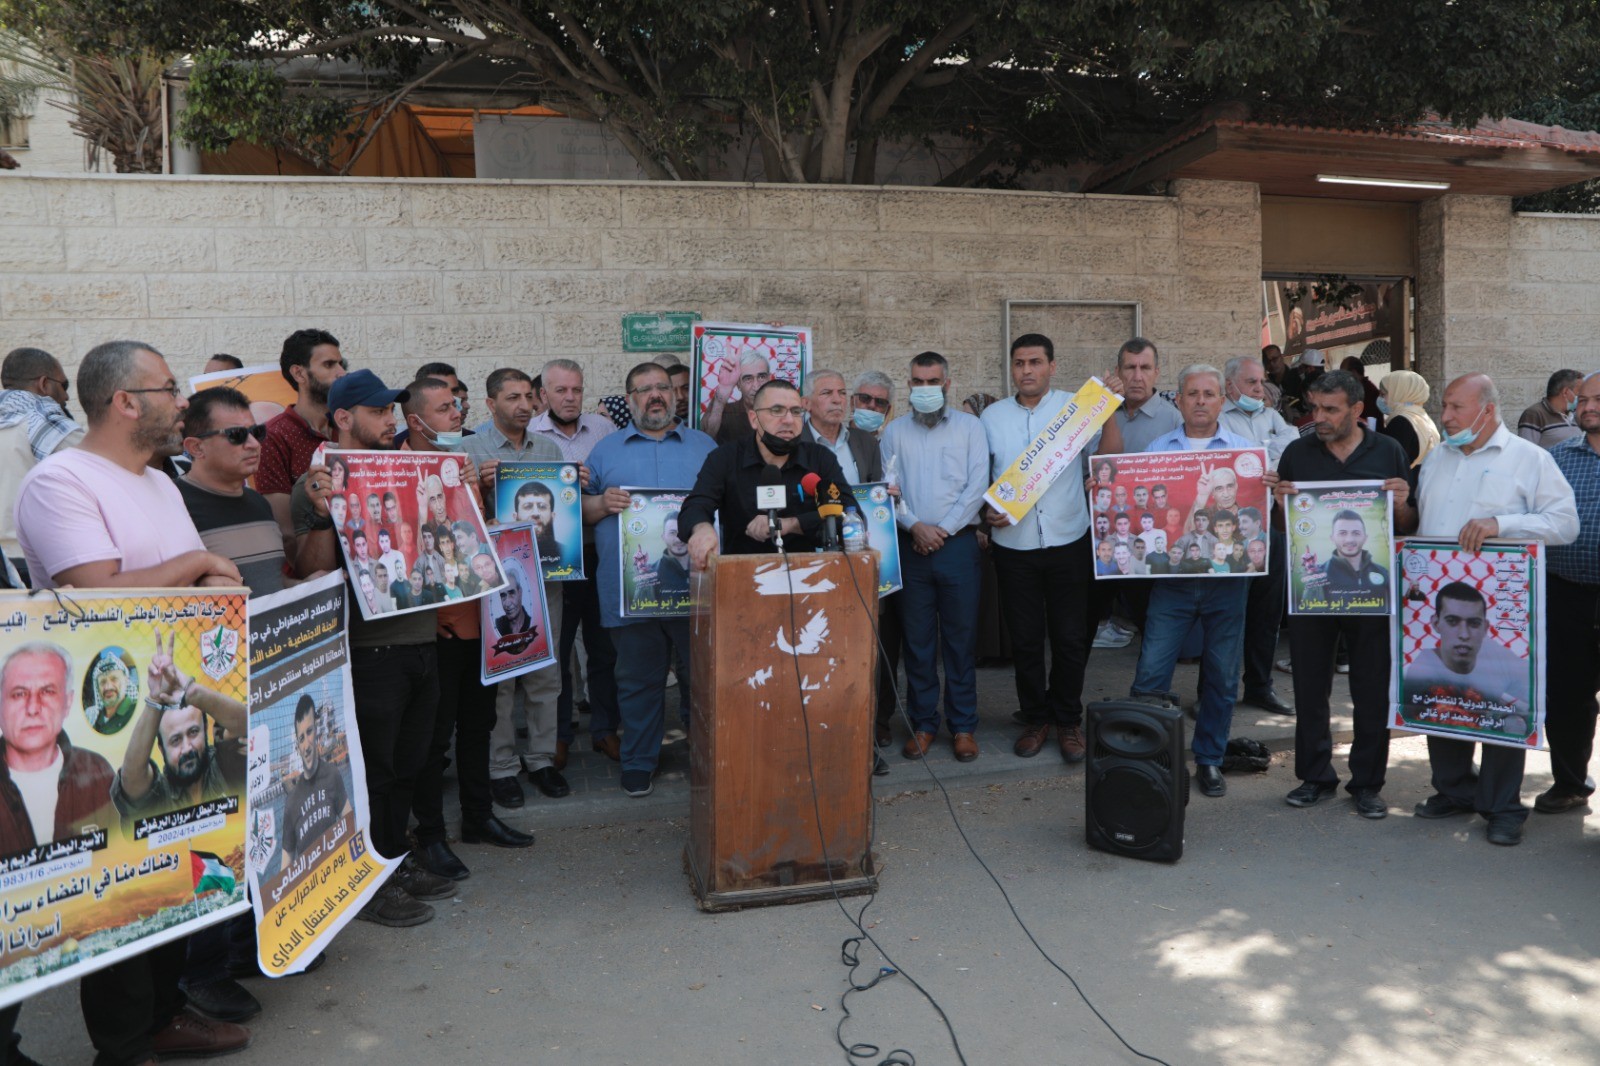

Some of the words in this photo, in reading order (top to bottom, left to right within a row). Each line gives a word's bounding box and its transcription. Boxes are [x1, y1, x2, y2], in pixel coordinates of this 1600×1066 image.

[70, 608, 124, 632] الفلسطيني
[125, 605, 161, 628] الوطني
[162, 605, 200, 624] التحرير
[201, 602, 227, 617] حركة
[301, 793, 316, 817] LIFE
[318, 789, 326, 801] IS
[300, 804, 331, 840] AWESOME
[157, 826, 196, 844] 2002/4/14
[350, 834, 366, 858] 15
[115, 866, 136, 884] منا
[138, 851, 179, 878] وهناك
[37, 876, 91, 911] الفضاء
[94, 867, 111, 900] في
[9, 912, 62, 950] أسرانا
